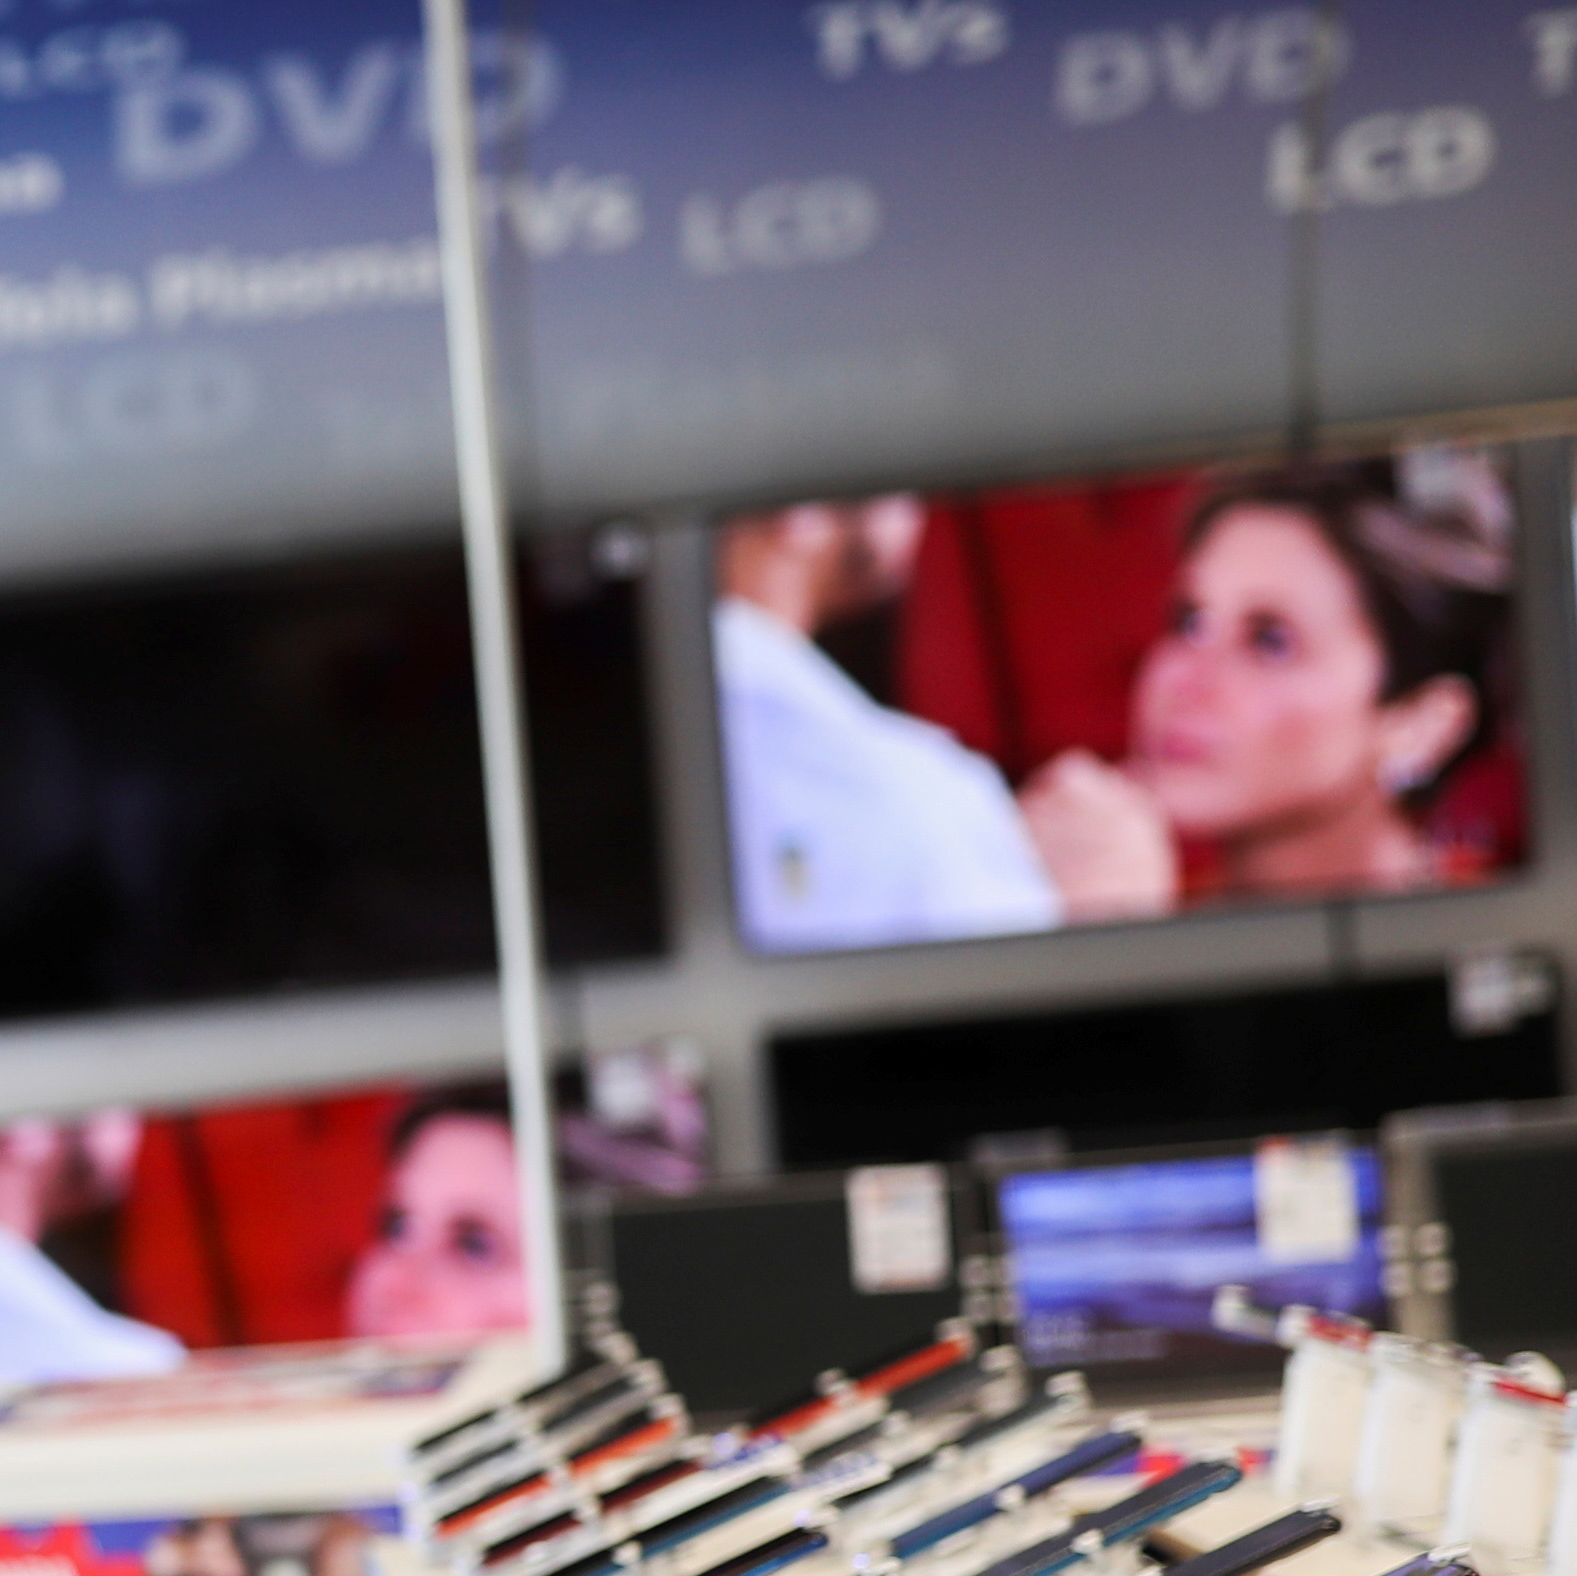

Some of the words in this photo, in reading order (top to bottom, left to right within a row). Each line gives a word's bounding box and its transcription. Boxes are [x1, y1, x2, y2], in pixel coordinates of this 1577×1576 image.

[812, 0, 1005, 76] TVs
[1059, 12, 1345, 122] DVD
[1269, 108, 1492, 212] LCD
[683, 180, 877, 274] LCD
